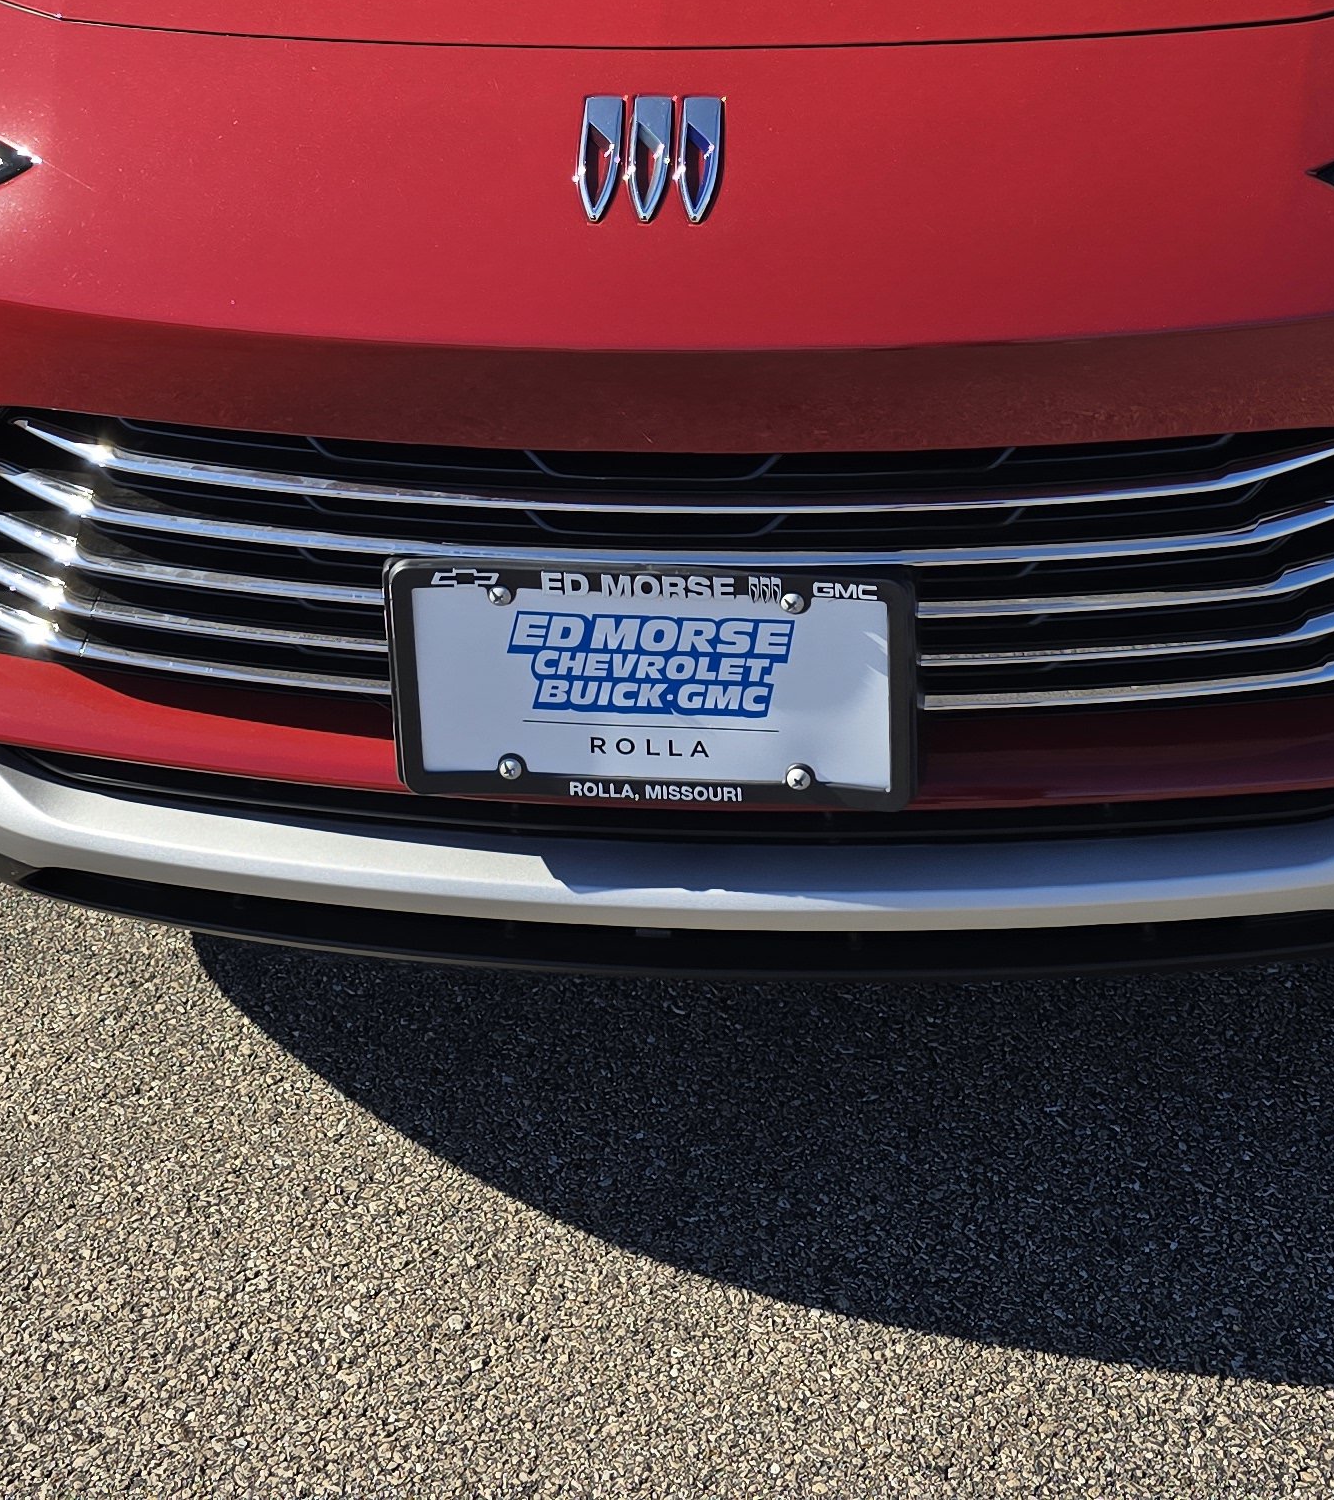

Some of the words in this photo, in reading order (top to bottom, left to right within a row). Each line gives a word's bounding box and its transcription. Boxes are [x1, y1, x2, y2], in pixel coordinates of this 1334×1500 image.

[540, 571, 590, 596] ED
[600, 573, 735, 600] MORSE
[812, 581, 878, 600] GMC
[511, 613, 585, 648] ED
[589, 616, 791, 655] MORSE
[534, 649, 770, 682] CHEVROLET
[589, 736, 710, 758] ROLLA
[569, 780, 640, 801] ROLLA,
[645, 784, 743, 802] MISSOURI
